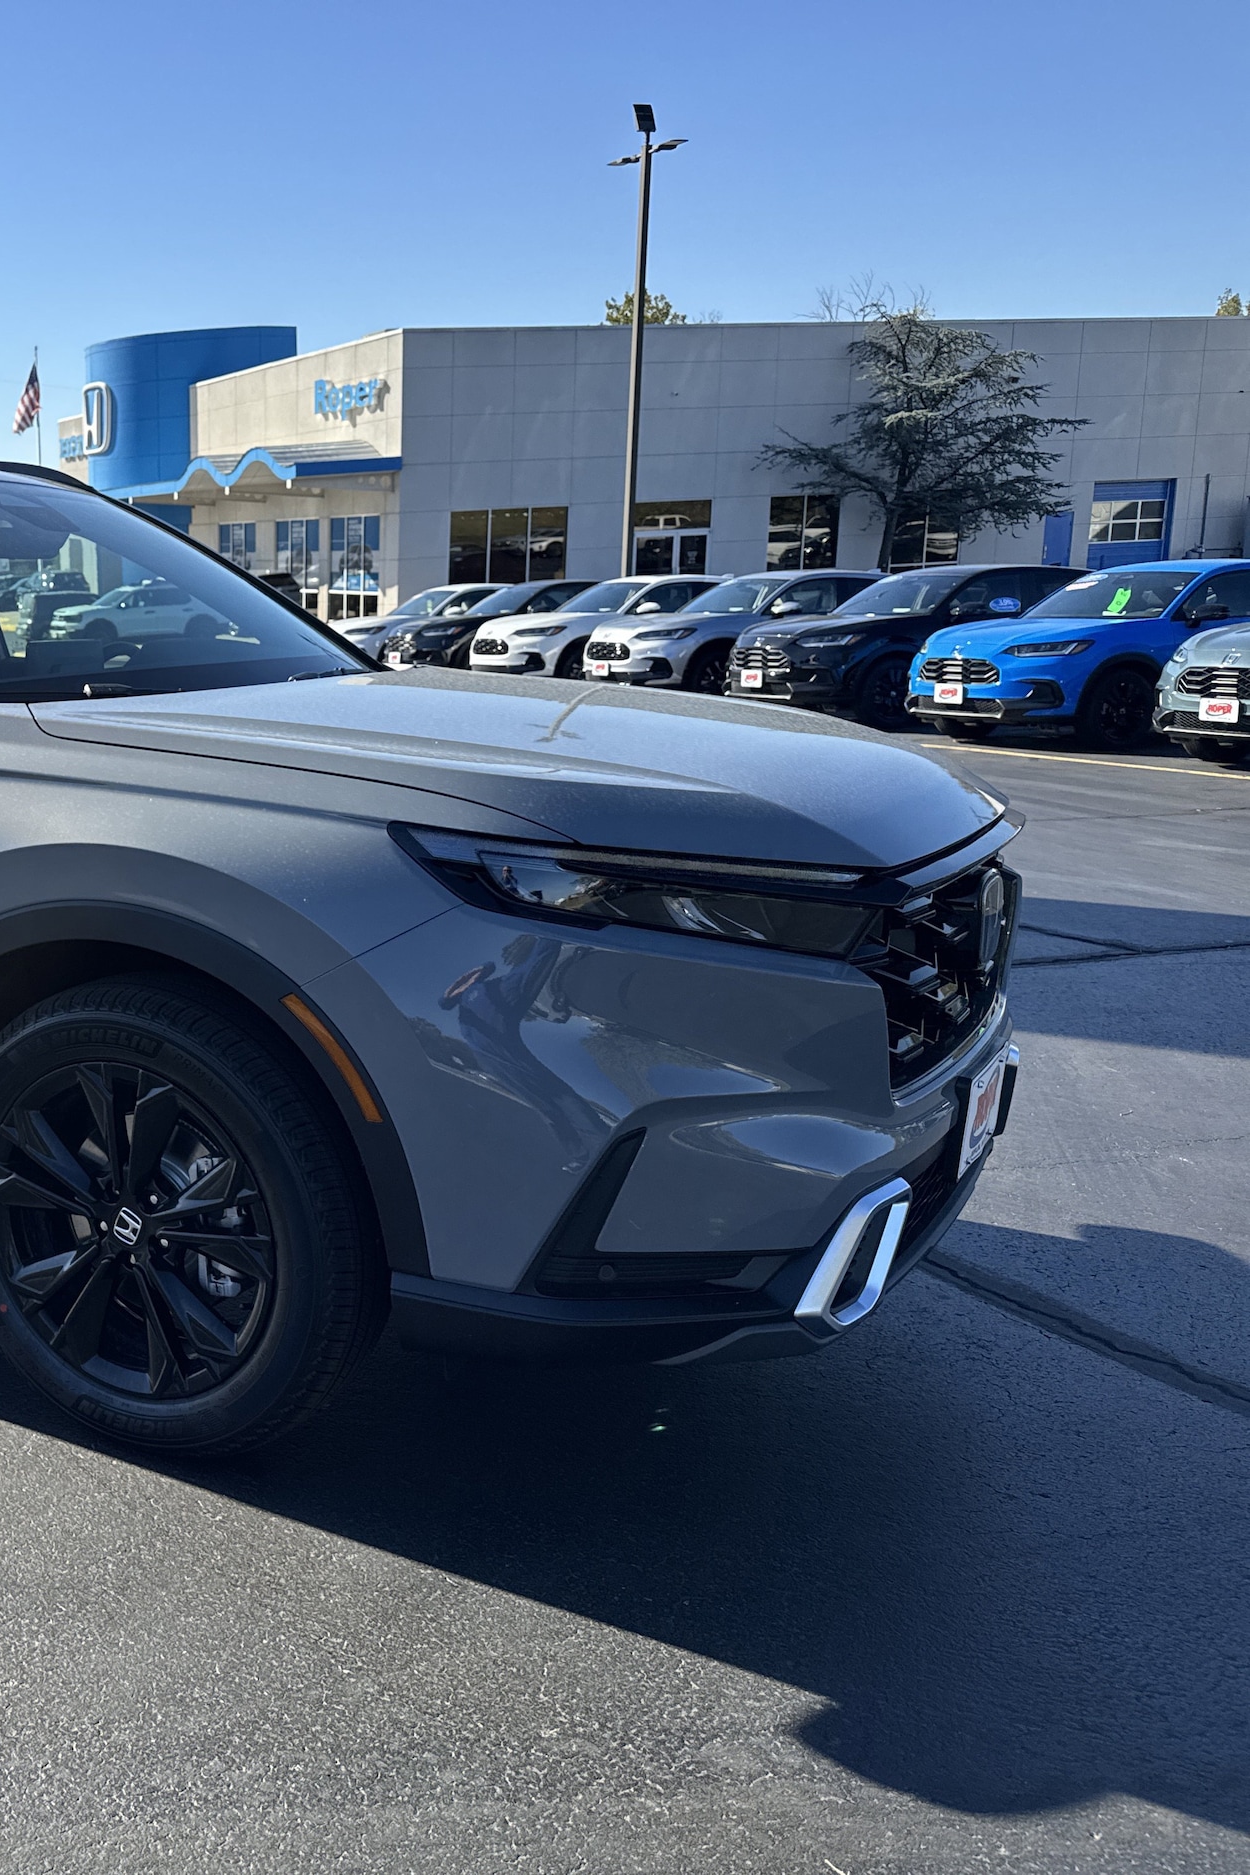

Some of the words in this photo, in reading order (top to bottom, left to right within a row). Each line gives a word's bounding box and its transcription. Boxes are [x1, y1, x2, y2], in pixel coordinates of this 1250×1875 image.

[314, 378, 379, 421] Roper
[1207, 703, 1232, 714] ROPER
[53, 1027, 158, 1055] MICHELIN
